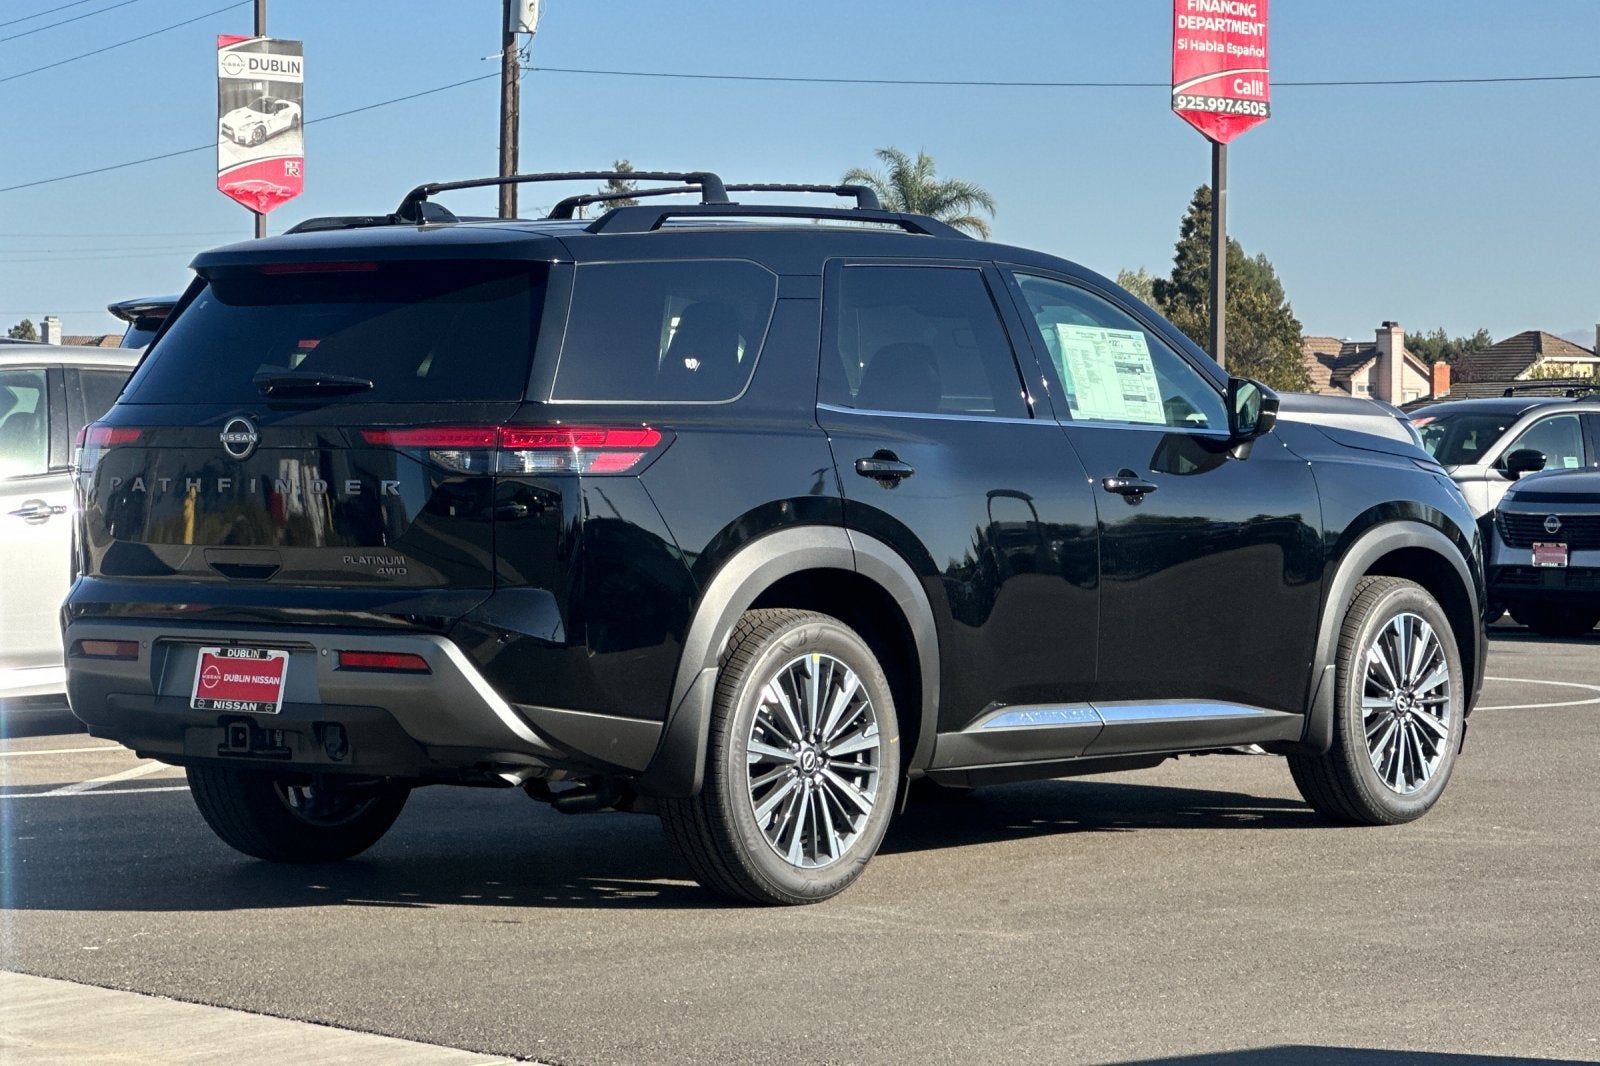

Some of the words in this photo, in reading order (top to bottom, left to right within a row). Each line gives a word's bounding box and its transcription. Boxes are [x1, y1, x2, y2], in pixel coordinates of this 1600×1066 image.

[1187, 0, 1257, 17] FINANCING
[1178, 15, 1265, 36] DEPARTMENT
[1177, 38, 1188, 50] Si
[1190, 39, 1225, 53] Habla
[1227, 42, 1265, 58] Español
[249, 58, 300, 73] DUBLIN
[1233, 79, 1264, 96] Call!
[1177, 95, 1267, 116] 925.997.4505
[220, 433, 258, 443] NISSAN
[109, 477, 400, 496] PATHFINDER
[343, 555, 406, 565] PLATINUM
[376, 567, 408, 575] 4WD
[227, 649, 260, 658] DUBLIN
[223, 673, 251, 682] DUBLIN
[251, 676, 280, 685] NISSAN
[213, 700, 258, 711] NISSAN
